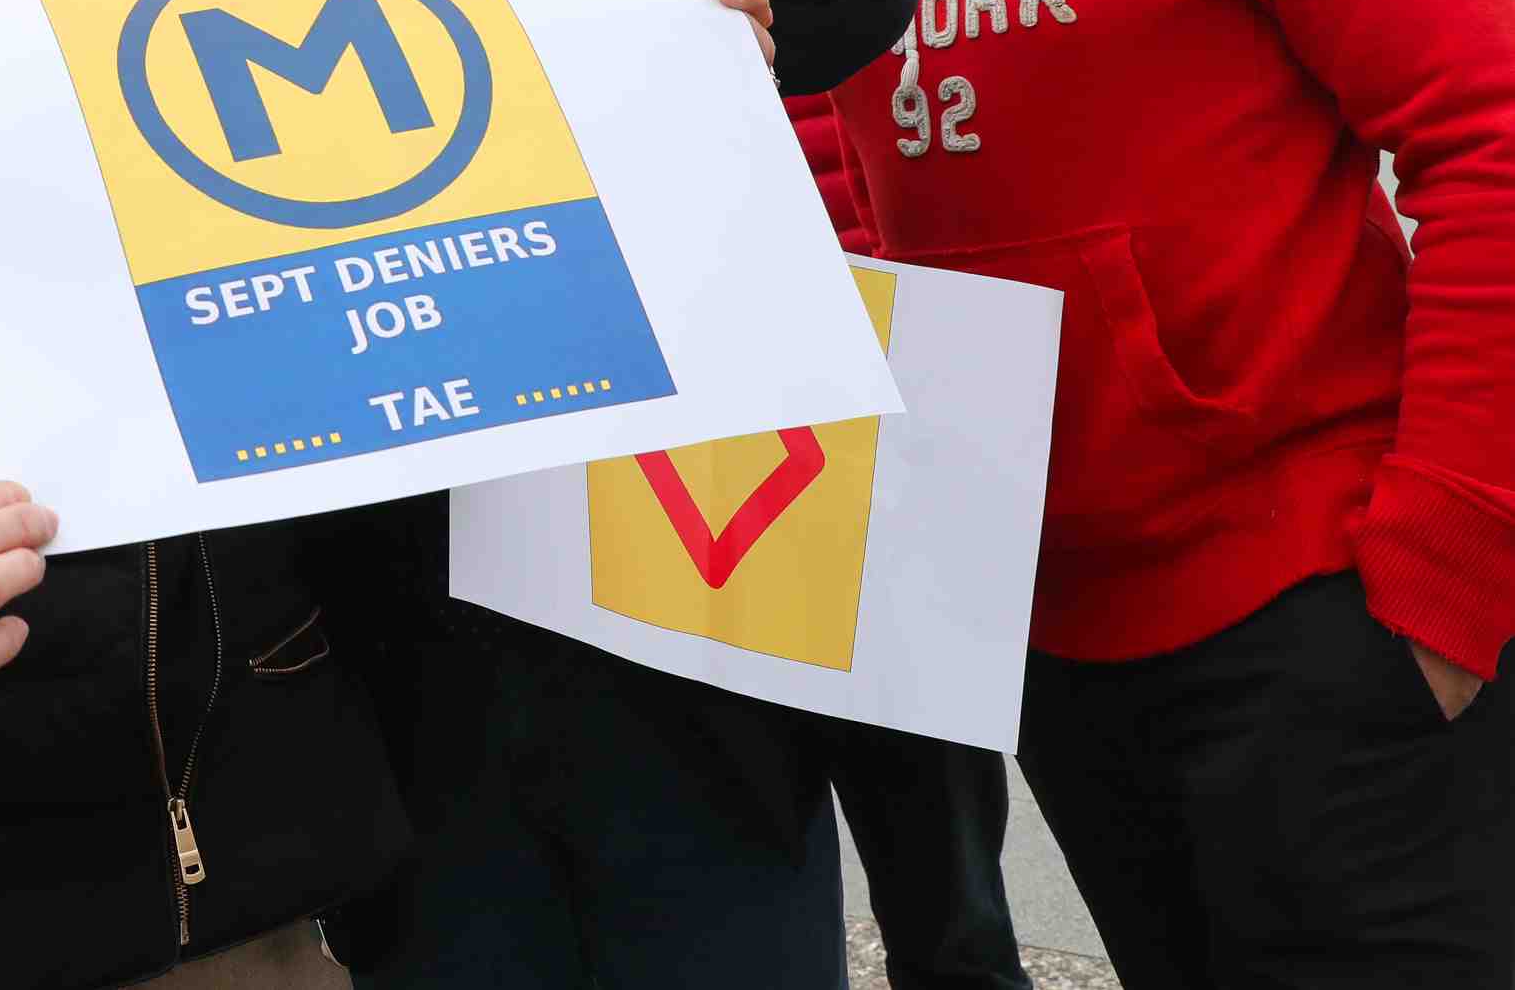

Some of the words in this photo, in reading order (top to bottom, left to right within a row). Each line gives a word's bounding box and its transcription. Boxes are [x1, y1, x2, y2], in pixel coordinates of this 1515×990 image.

[891, 75, 982, 157] 92
[184, 265, 318, 326] SEPT
[333, 219, 558, 293] DENIERS
[345, 293, 443, 355] JOB
[369, 377, 481, 432] TAE
